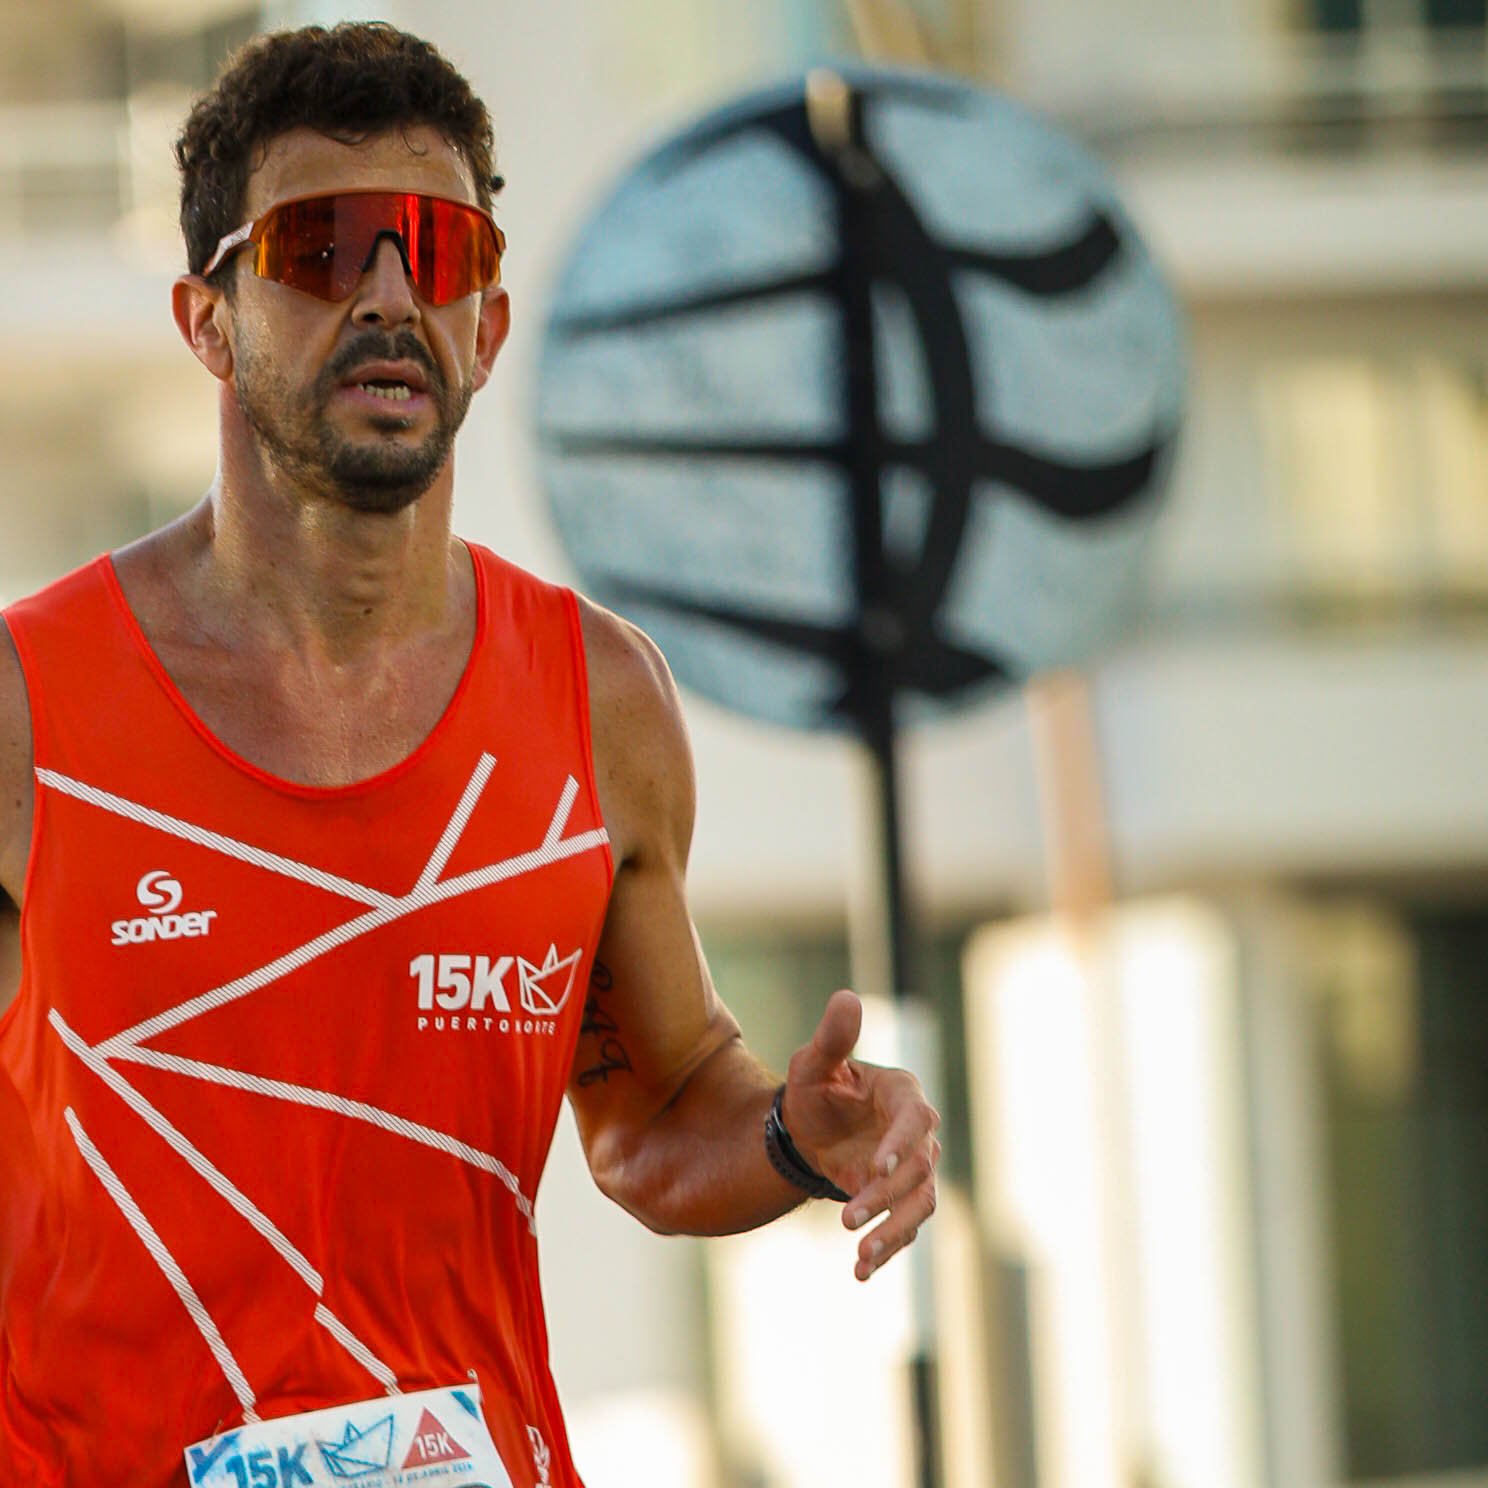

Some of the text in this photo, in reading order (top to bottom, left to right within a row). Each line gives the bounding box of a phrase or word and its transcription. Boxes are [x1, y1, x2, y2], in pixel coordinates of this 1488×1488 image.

[410, 954, 514, 1013] 15K
[417, 1016, 510, 1033] PUERTO
[414, 1431, 455, 1461] 15K
